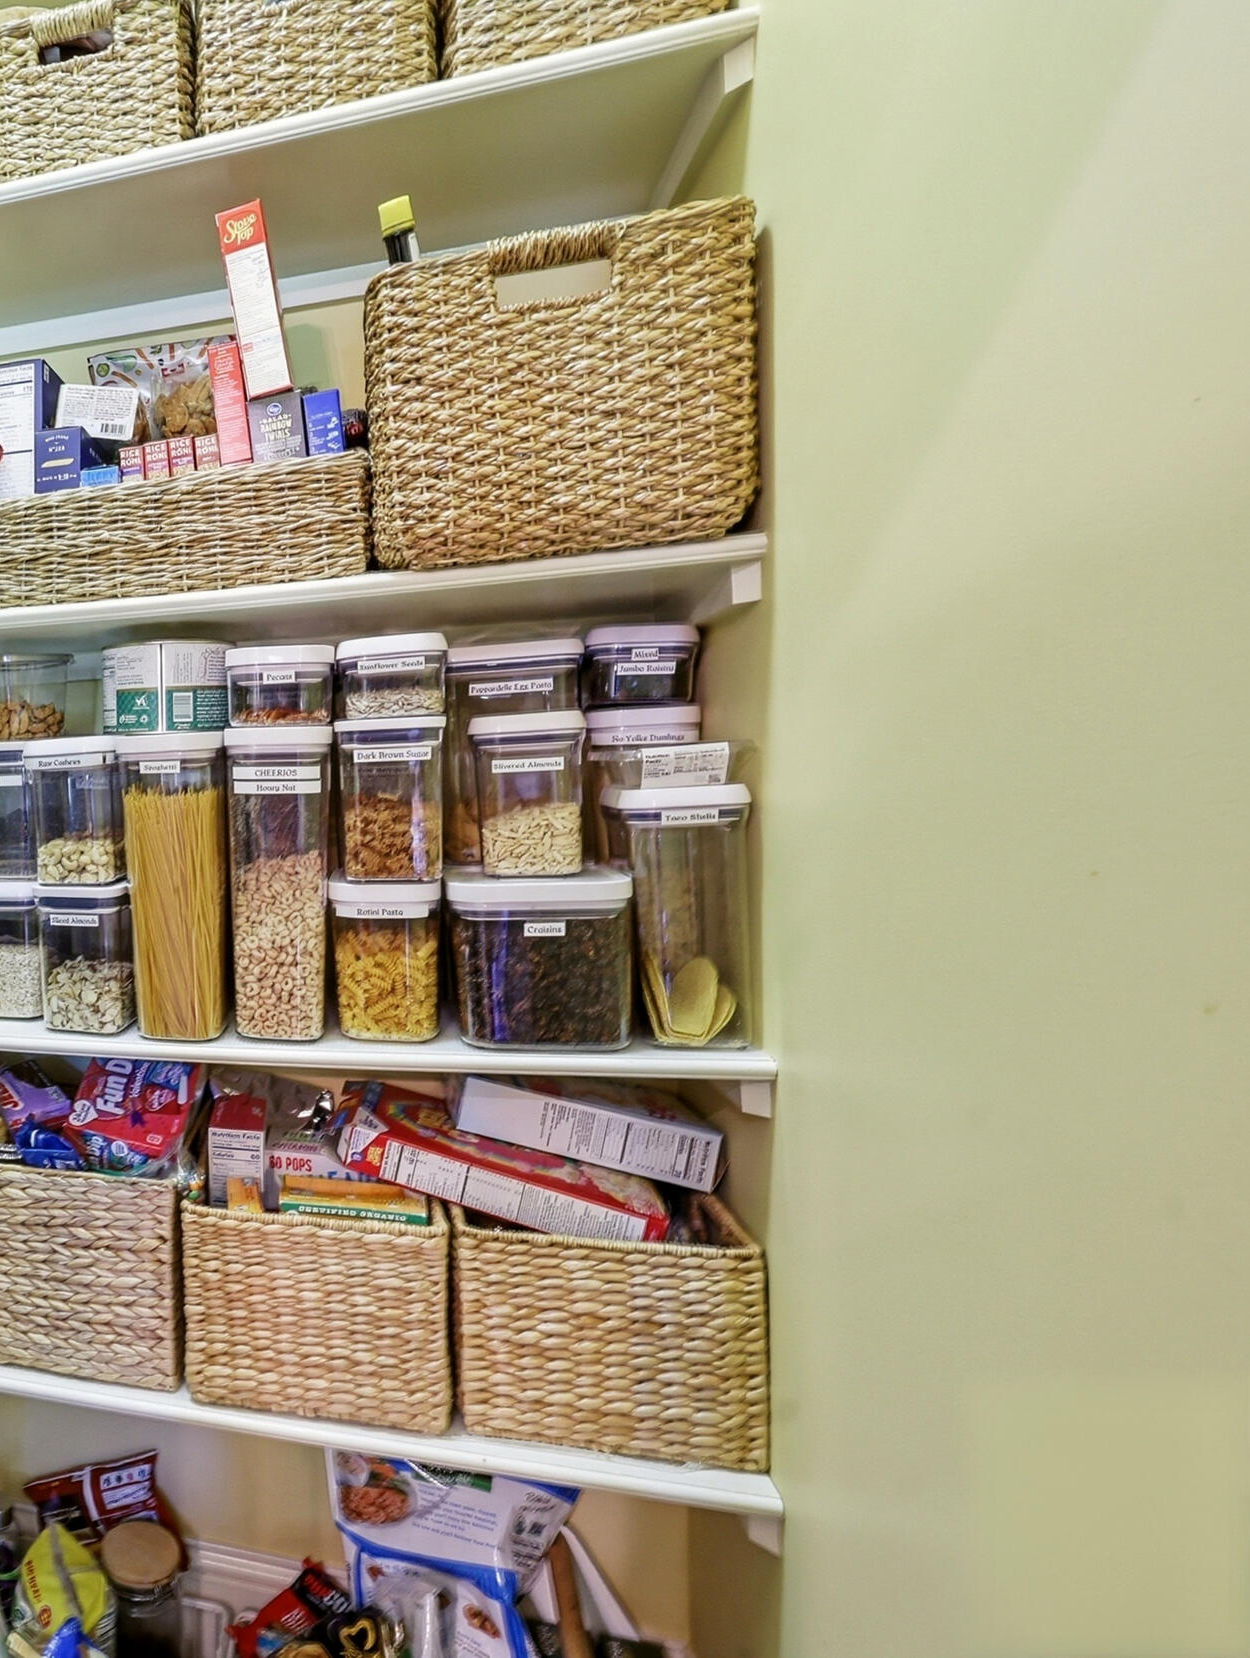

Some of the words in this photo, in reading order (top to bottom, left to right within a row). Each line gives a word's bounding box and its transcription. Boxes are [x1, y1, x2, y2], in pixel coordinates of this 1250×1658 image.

[223, 212, 257, 244] Stove
[237, 225, 255, 245] Top
[170, 439, 190, 448] RICE
[195, 437, 215, 446] RICE
[120, 448, 140, 458] RICE
[145, 444, 165, 453] RICE
[634, 650, 658, 658] Mixed
[359, 662, 399, 671] Sunflower
[401, 660, 423, 668] Seeds
[619, 664, 644, 673] Jumbo
[514, 682, 529, 691] Egg
[531, 681, 552, 690] Pasta
[356, 751, 377, 760] Dark
[378, 751, 405, 760] Brown
[406, 750, 429, 760] Sugar
[38, 760, 53, 768] Raw
[54, 758, 81, 767] Cashews
[143, 763, 177, 772] Spaghetti
[493, 761, 525, 770] Slivered
[527, 760, 562, 769] Almonds
[254, 769, 298, 777] CHEERIOS
[256, 784, 280, 793] Honey
[281, 784, 296, 792] Nut
[664, 814, 687, 822] Taco
[689, 812, 716, 821] Shells
[356, 907, 380, 915] Rotini
[381, 908, 403, 916] Pasta
[527, 925, 562, 935] Craisins
[96, 1075, 129, 1115] Fun
[211, 1131, 241, 1140] Nutrition
[242, 1132, 260, 1140] Facts
[285, 1156, 312, 1172] POPS
[298, 1205, 357, 1217] CERTIFIED
[359, 1210, 407, 1222] ORGANIC
